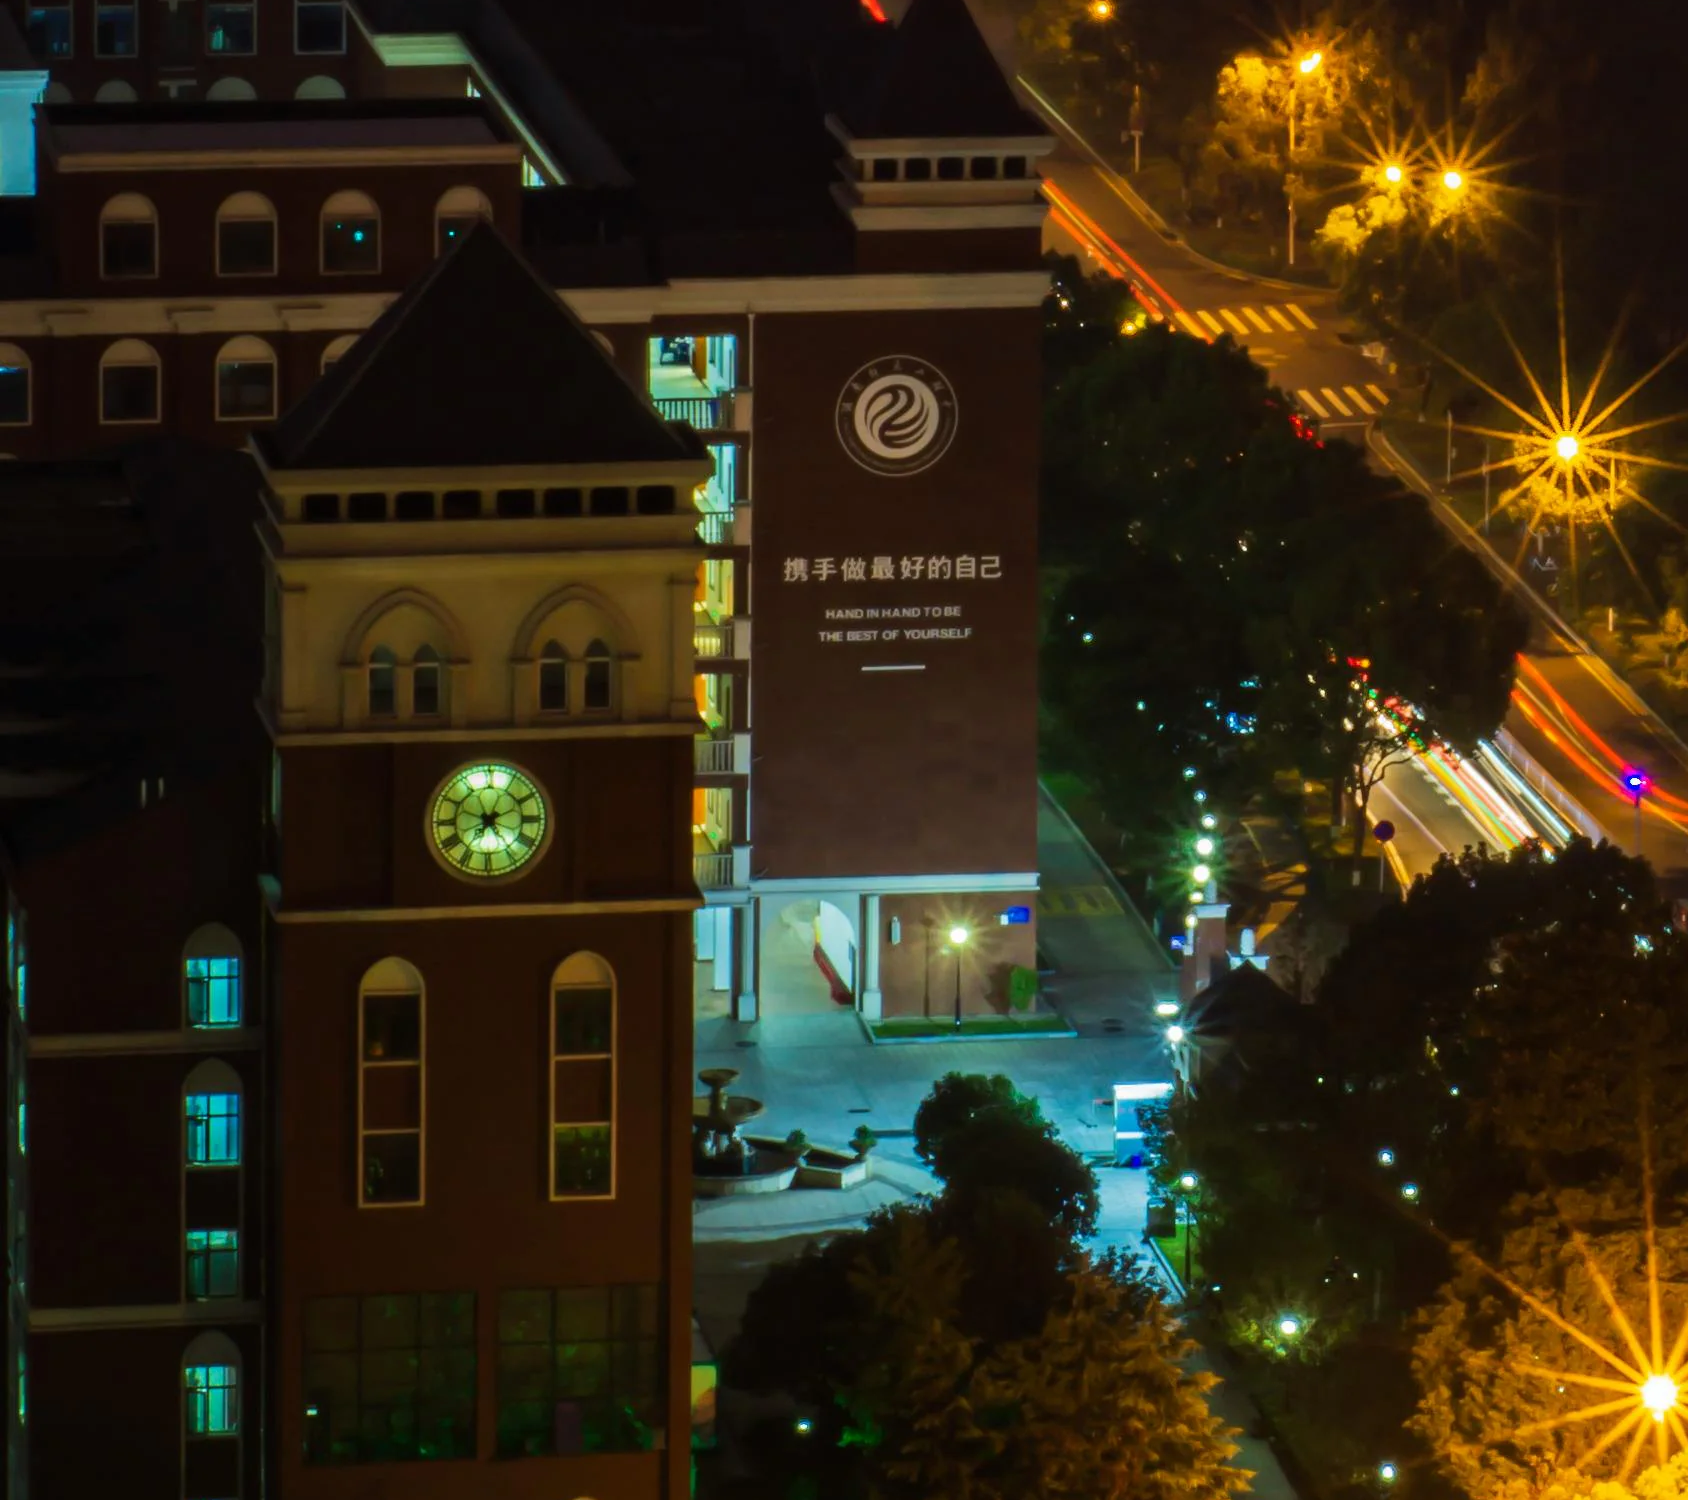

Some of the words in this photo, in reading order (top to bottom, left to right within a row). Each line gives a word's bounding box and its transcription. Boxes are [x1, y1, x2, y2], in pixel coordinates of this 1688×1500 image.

[783, 554, 1003, 583] 携手做最好的自己
[825, 608, 864, 620] HAND
[866, 608, 879, 619] IN
[882, 607, 921, 618] HAND
[924, 606, 942, 618] TO
[944, 605, 961, 617] BE
[818, 631, 843, 642] THE
[846, 630, 878, 642] BEST
[882, 629, 900, 641] OF
[903, 627, 972, 640] YOURSELF
